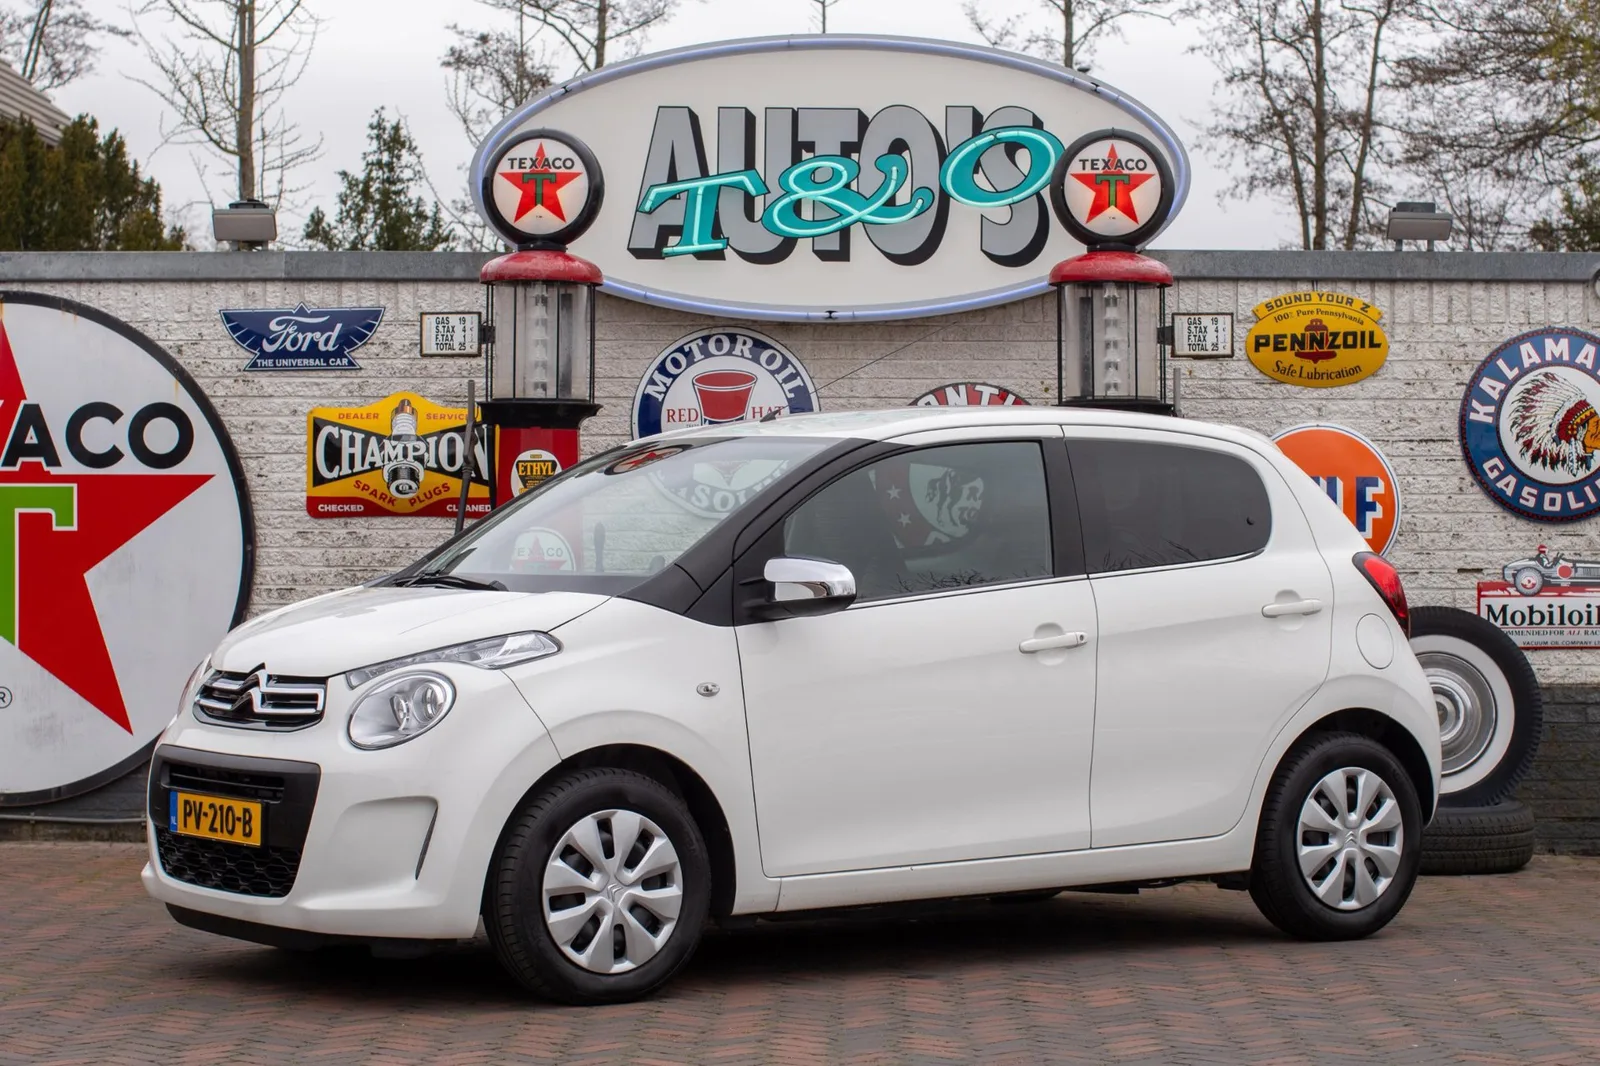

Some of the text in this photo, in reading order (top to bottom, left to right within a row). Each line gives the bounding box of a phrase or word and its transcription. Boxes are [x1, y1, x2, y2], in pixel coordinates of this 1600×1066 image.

[508, 158, 575, 170] TEXACO
[1079, 159, 1147, 171] TEXACO
[1265, 293, 1371, 313] SOUND YOUR Z
[435, 316, 466, 325] GAS 19
[1187, 317, 1219, 325] GAS 19
[1296, 309, 1315, 317] Pure
[1316, 308, 1364, 326] Pennsylvania
[262, 315, 343, 353] Ford
[1187, 326, 1208, 334] S.TAX
[435, 334, 454, 342] F.TAX
[1254, 330, 1382, 353] PENNZOIL
[1188, 343, 1219, 351] TOTAL 25
[256, 358, 349, 367] THE UNIVERSAL CAR
[644, 334, 804, 402] MOTOR OIL
[1272, 360, 1362, 380] Safe Lubrication
[1469, 338, 1600, 424] KALAMA
[338, 412, 470, 421] DEALER SERVIC
[666, 408, 699, 423] RED
[315, 423, 488, 481] CHAMPION
[518, 462, 555, 476] ETHYL
[1482, 457, 1600, 512] GASOLI
[353, 479, 451, 507] SPARK PLUGS
[318, 504, 492, 512] CHECKED CLANED
[170, 816, 178, 825] NL
[183, 799, 253, 838] PV-210-B
